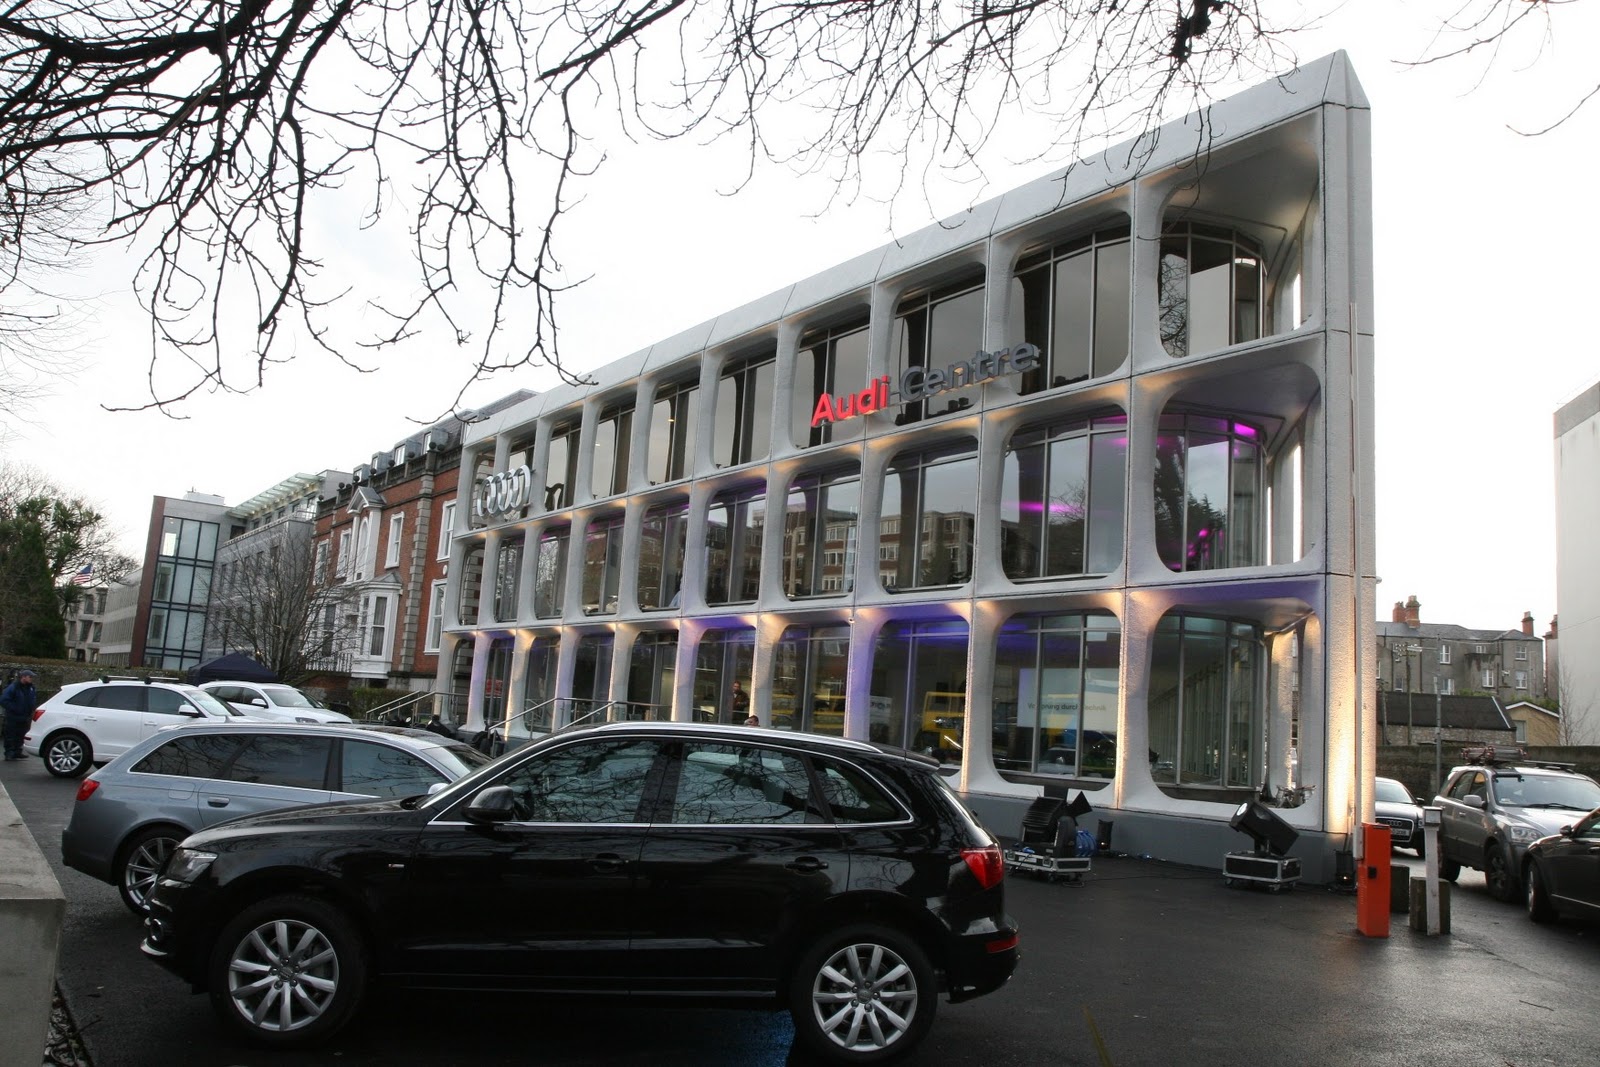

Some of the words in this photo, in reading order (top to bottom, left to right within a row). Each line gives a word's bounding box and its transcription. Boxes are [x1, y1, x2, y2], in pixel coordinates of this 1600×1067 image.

[811, 375, 890, 427] Audi
[900, 342, 1037, 401] Centre
[1027, 702, 1060, 711] Voprung
[1083, 703, 1107, 711] echnik
